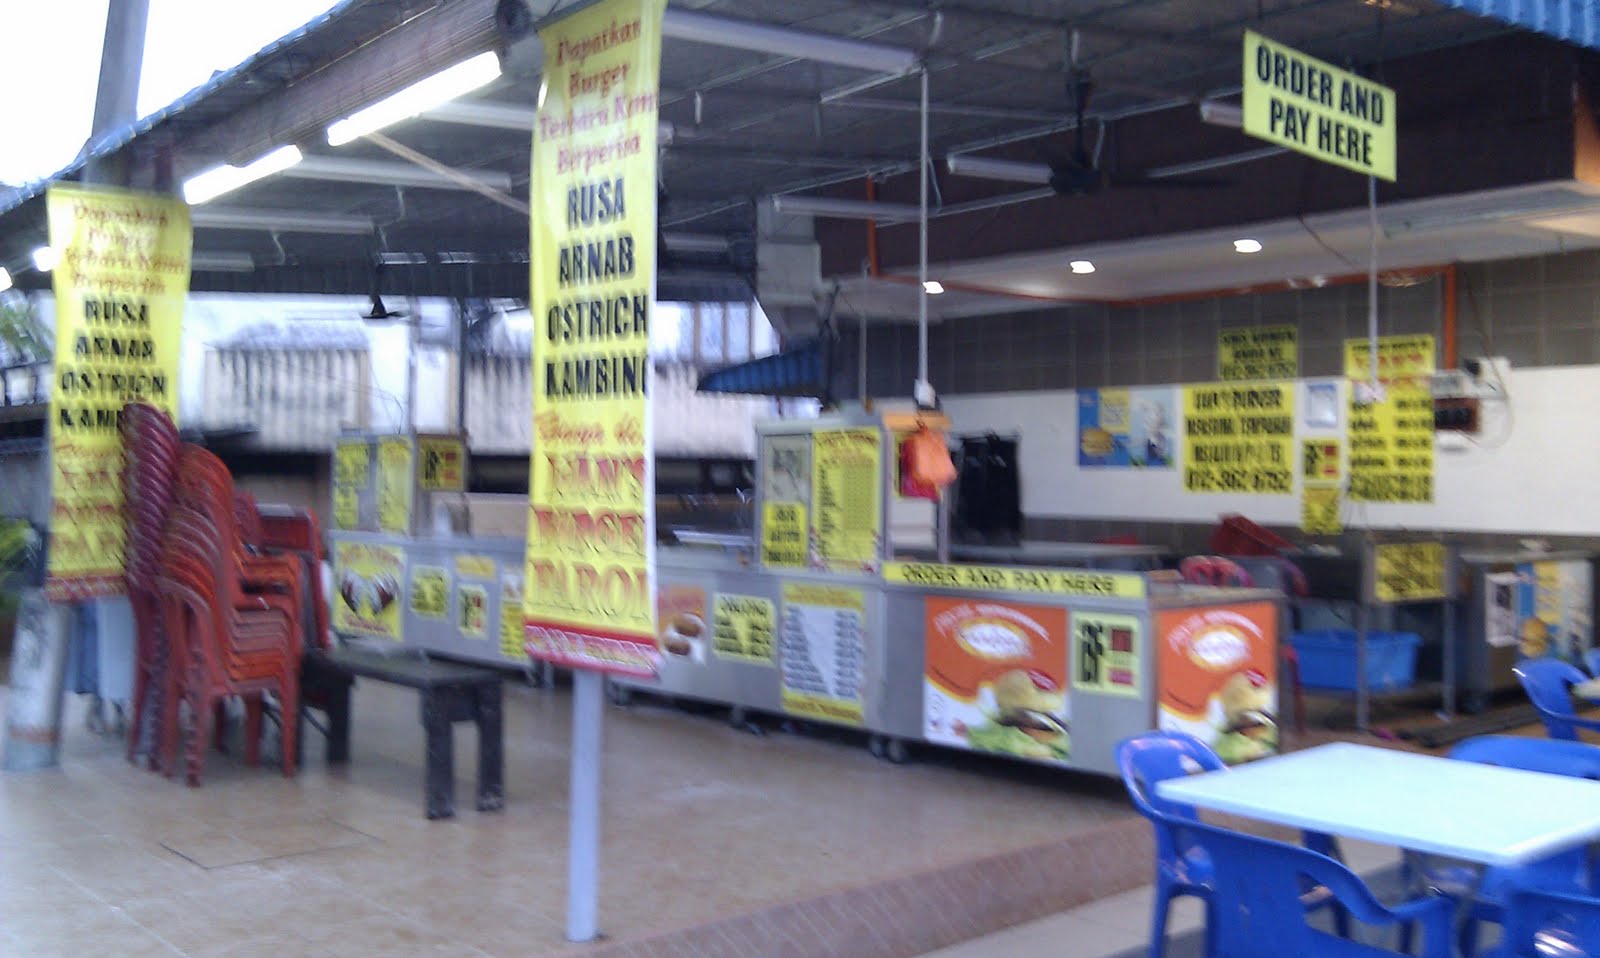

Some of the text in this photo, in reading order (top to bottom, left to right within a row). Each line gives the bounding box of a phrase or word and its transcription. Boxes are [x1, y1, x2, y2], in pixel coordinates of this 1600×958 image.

[568, 63, 629, 98] Burger
[1257, 43, 1384, 126] ORDER AND
[1270, 97, 1373, 168] PAY HERE
[567, 177, 625, 231] RUSA
[558, 235, 635, 288] ARNAB
[84, 298, 151, 325] RUSA
[547, 294, 649, 347] OSTRICH
[75, 334, 156, 361] ARNAB
[902, 562, 1117, 597] ORDER AND PAY HERE
